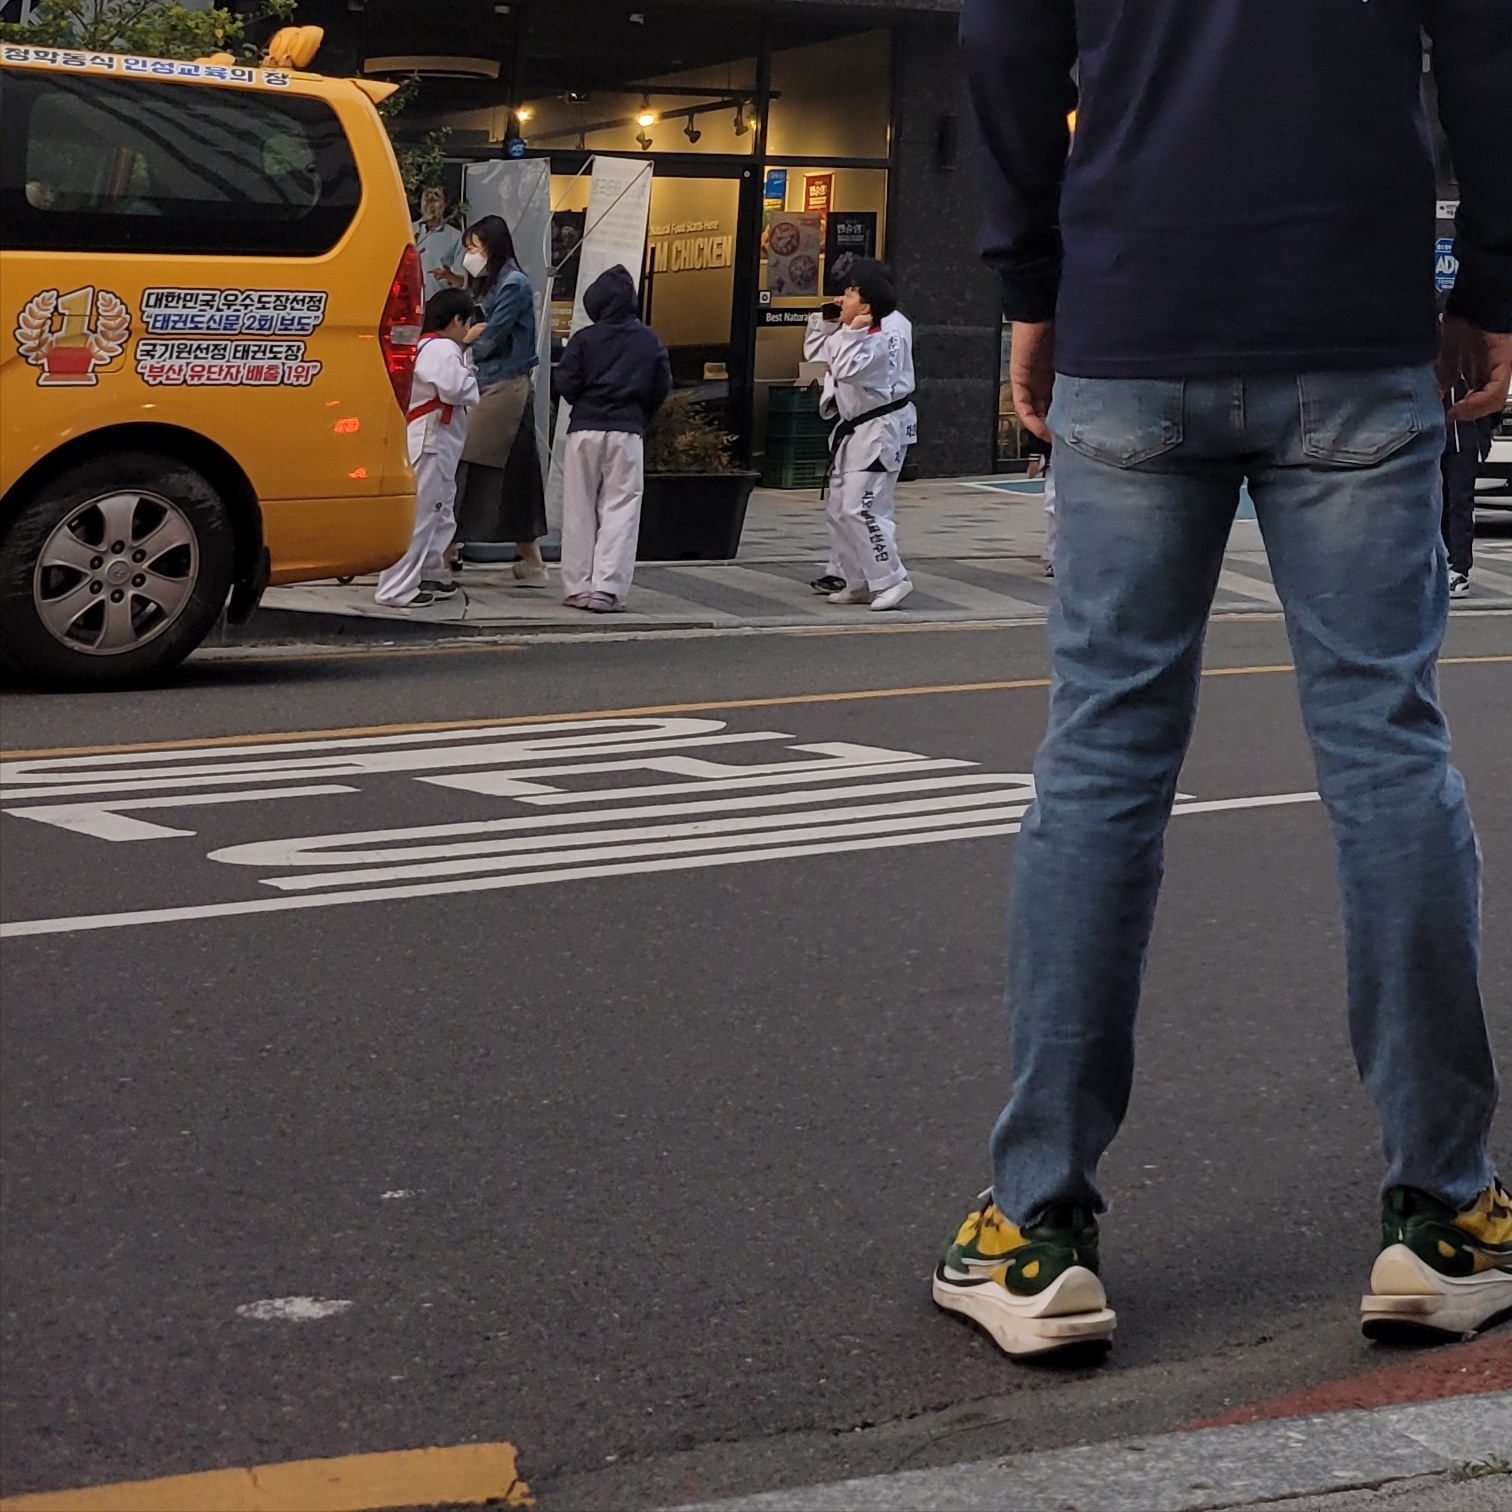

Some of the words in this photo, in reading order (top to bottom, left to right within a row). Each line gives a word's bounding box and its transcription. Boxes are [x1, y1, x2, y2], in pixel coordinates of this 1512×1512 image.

[123, 57, 254, 84] 인성교육의
[671, 234, 733, 274] CHICKEN
[145, 291, 217, 312] 대한민국
[221, 292, 324, 313] 우수도장선정
[243, 314, 274, 333] 2회
[139, 342, 227, 362] 국기원선정
[232, 343, 302, 363] 태권도장
[187, 364, 241, 383] 유단자
